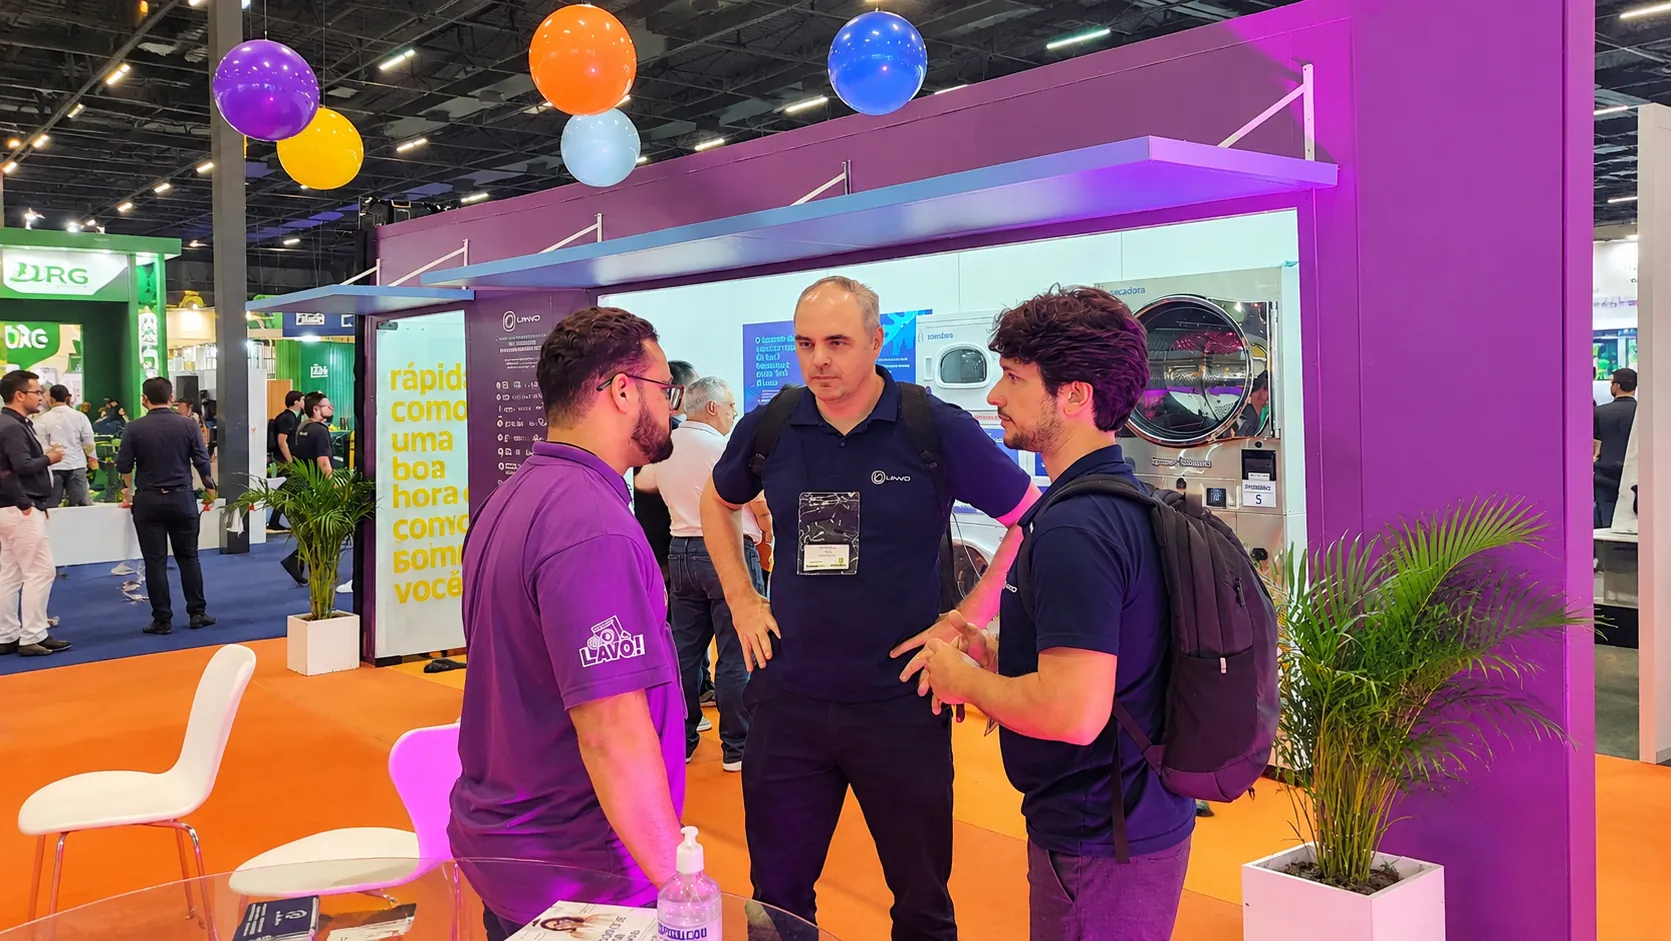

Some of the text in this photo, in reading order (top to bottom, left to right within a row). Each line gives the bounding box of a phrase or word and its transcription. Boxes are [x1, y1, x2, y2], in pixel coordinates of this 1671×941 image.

[1110, 286, 1146, 296] secadora
[391, 400, 468, 422] como
[391, 431, 454, 452] uma
[392, 456, 446, 481] boa
[393, 484, 459, 509] hora
